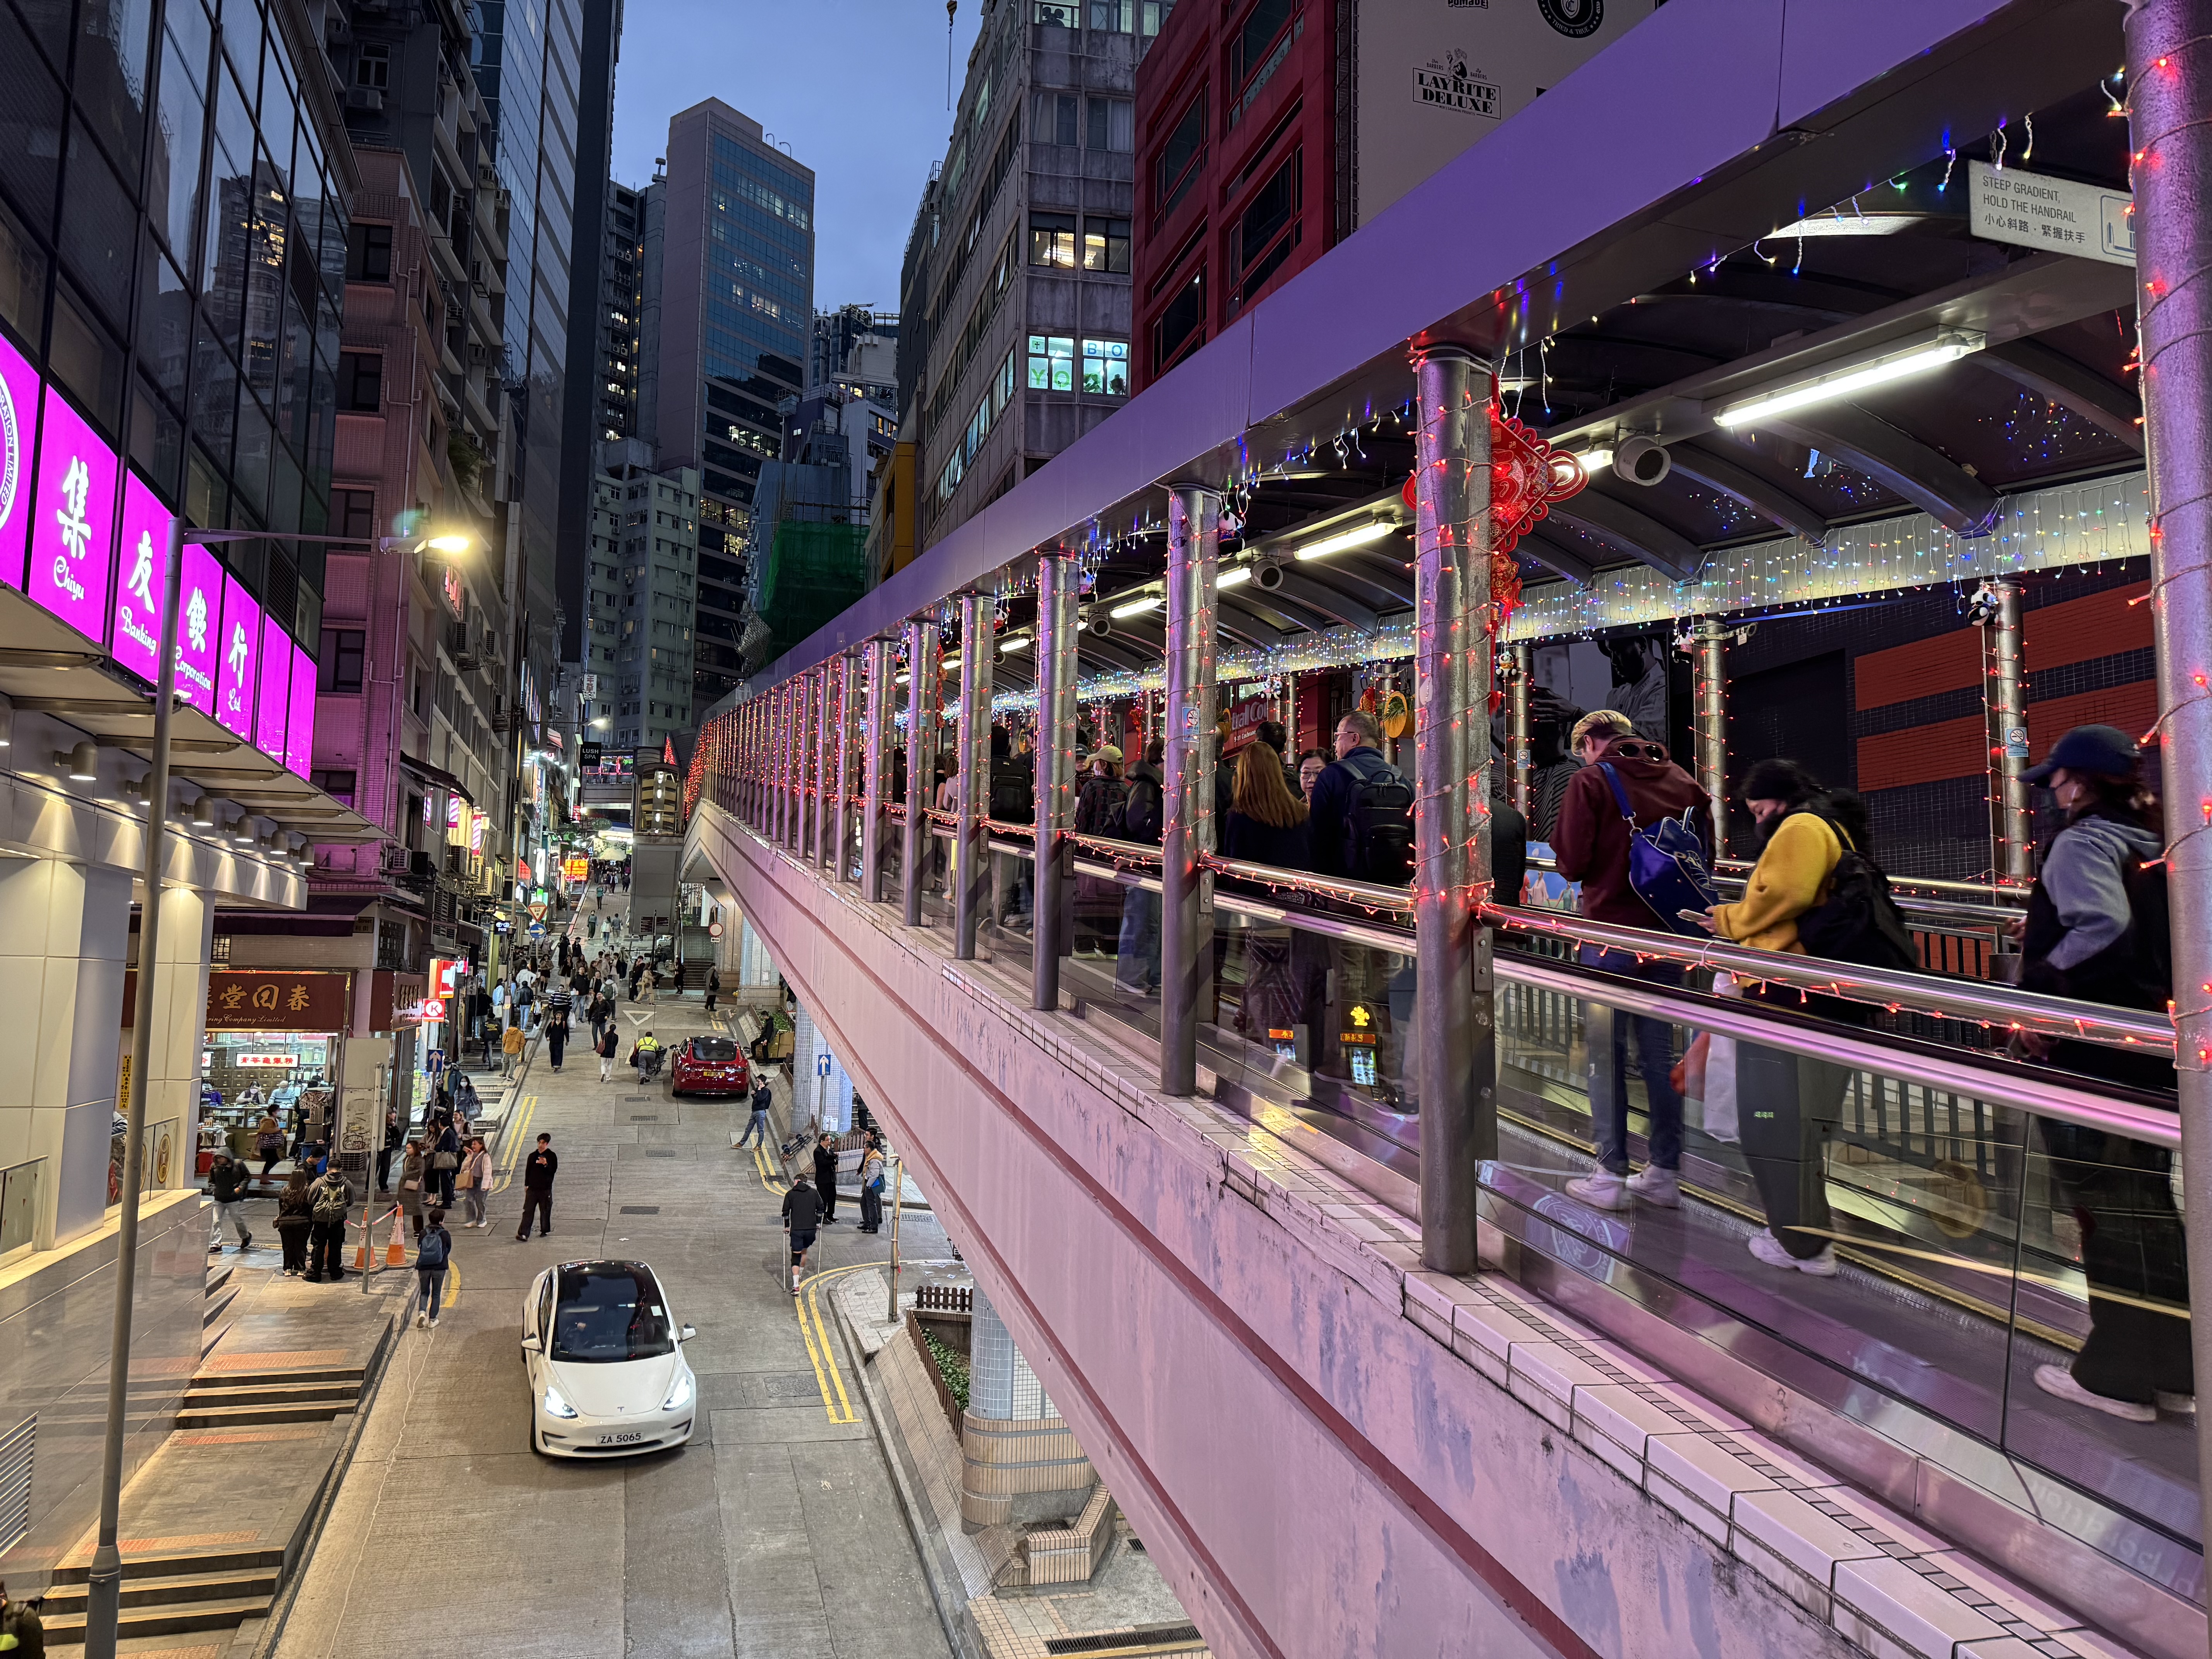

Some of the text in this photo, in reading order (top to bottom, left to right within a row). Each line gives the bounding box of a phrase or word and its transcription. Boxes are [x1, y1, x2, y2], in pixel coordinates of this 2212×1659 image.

[1553, 19, 1568, 33] TRIED
[1427, 62, 1443, 70] BARBERS
[1470, 72, 1487, 80] BARBERS
[1418, 72, 1496, 101] LAYRITE
[1422, 88, 1492, 114] DELUXE
[1983, 176, 2060, 203] STEEP GRADIENT,
[1984, 193, 2076, 223] HOLD THE HANDRAIL
[0, 388, 14, 505] RATION LIMITED
[53, 555, 84, 601] Chiyu
[121, 606, 157, 657] Banking
[228, 688, 241, 713] Ltd
[1231, 704, 1250, 731] tral
[223, 1014, 256, 1025] Company
[257, 1015, 286, 1023] Limited
[616, 1433, 641, 1443] 5065
